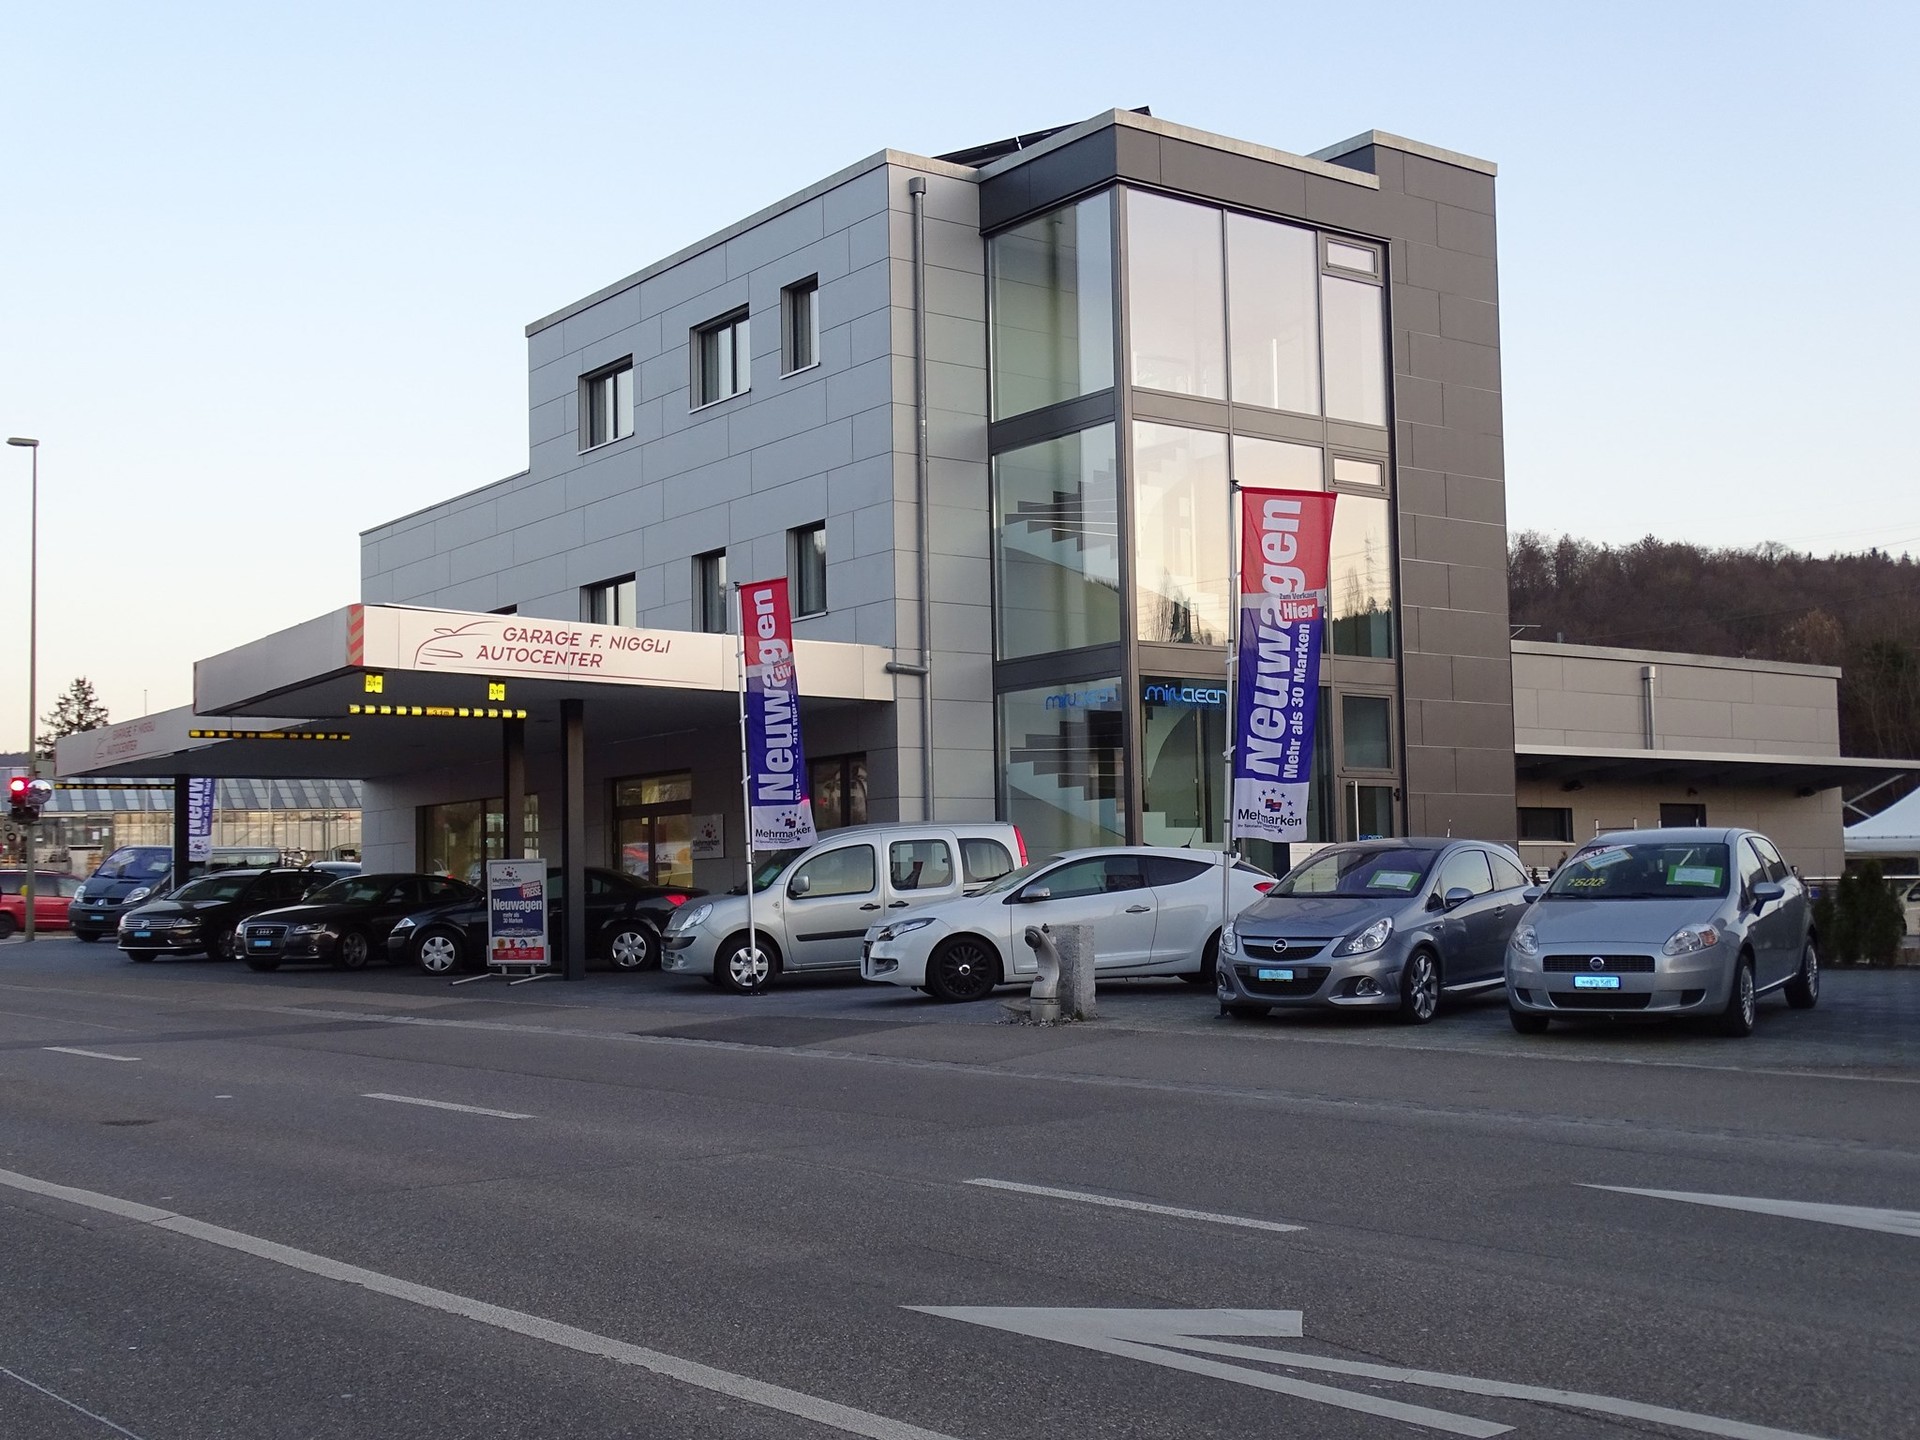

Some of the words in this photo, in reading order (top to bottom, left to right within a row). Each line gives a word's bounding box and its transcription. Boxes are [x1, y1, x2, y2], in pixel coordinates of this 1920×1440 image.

[1291, 591, 1317, 600] Verkauf
[1282, 601, 1316, 620] Hier
[503, 626, 583, 647] GARAGE
[589, 634, 603, 649] F.
[608, 635, 672, 654] NIGGLI
[1245, 498, 1306, 777] Neuwagen
[476, 645, 603, 668] AUTOCENTER
[1293, 623, 1311, 684] Marken
[752, 588, 796, 802] Neuwagen
[1291, 687, 1305, 708] 30
[1287, 706, 1303, 735] als
[1282, 737, 1301, 779] Mehr
[189, 778, 204, 834] Neuw
[493, 899, 543, 913] Neuwagen
[523, 887, 542, 898] PREISE
